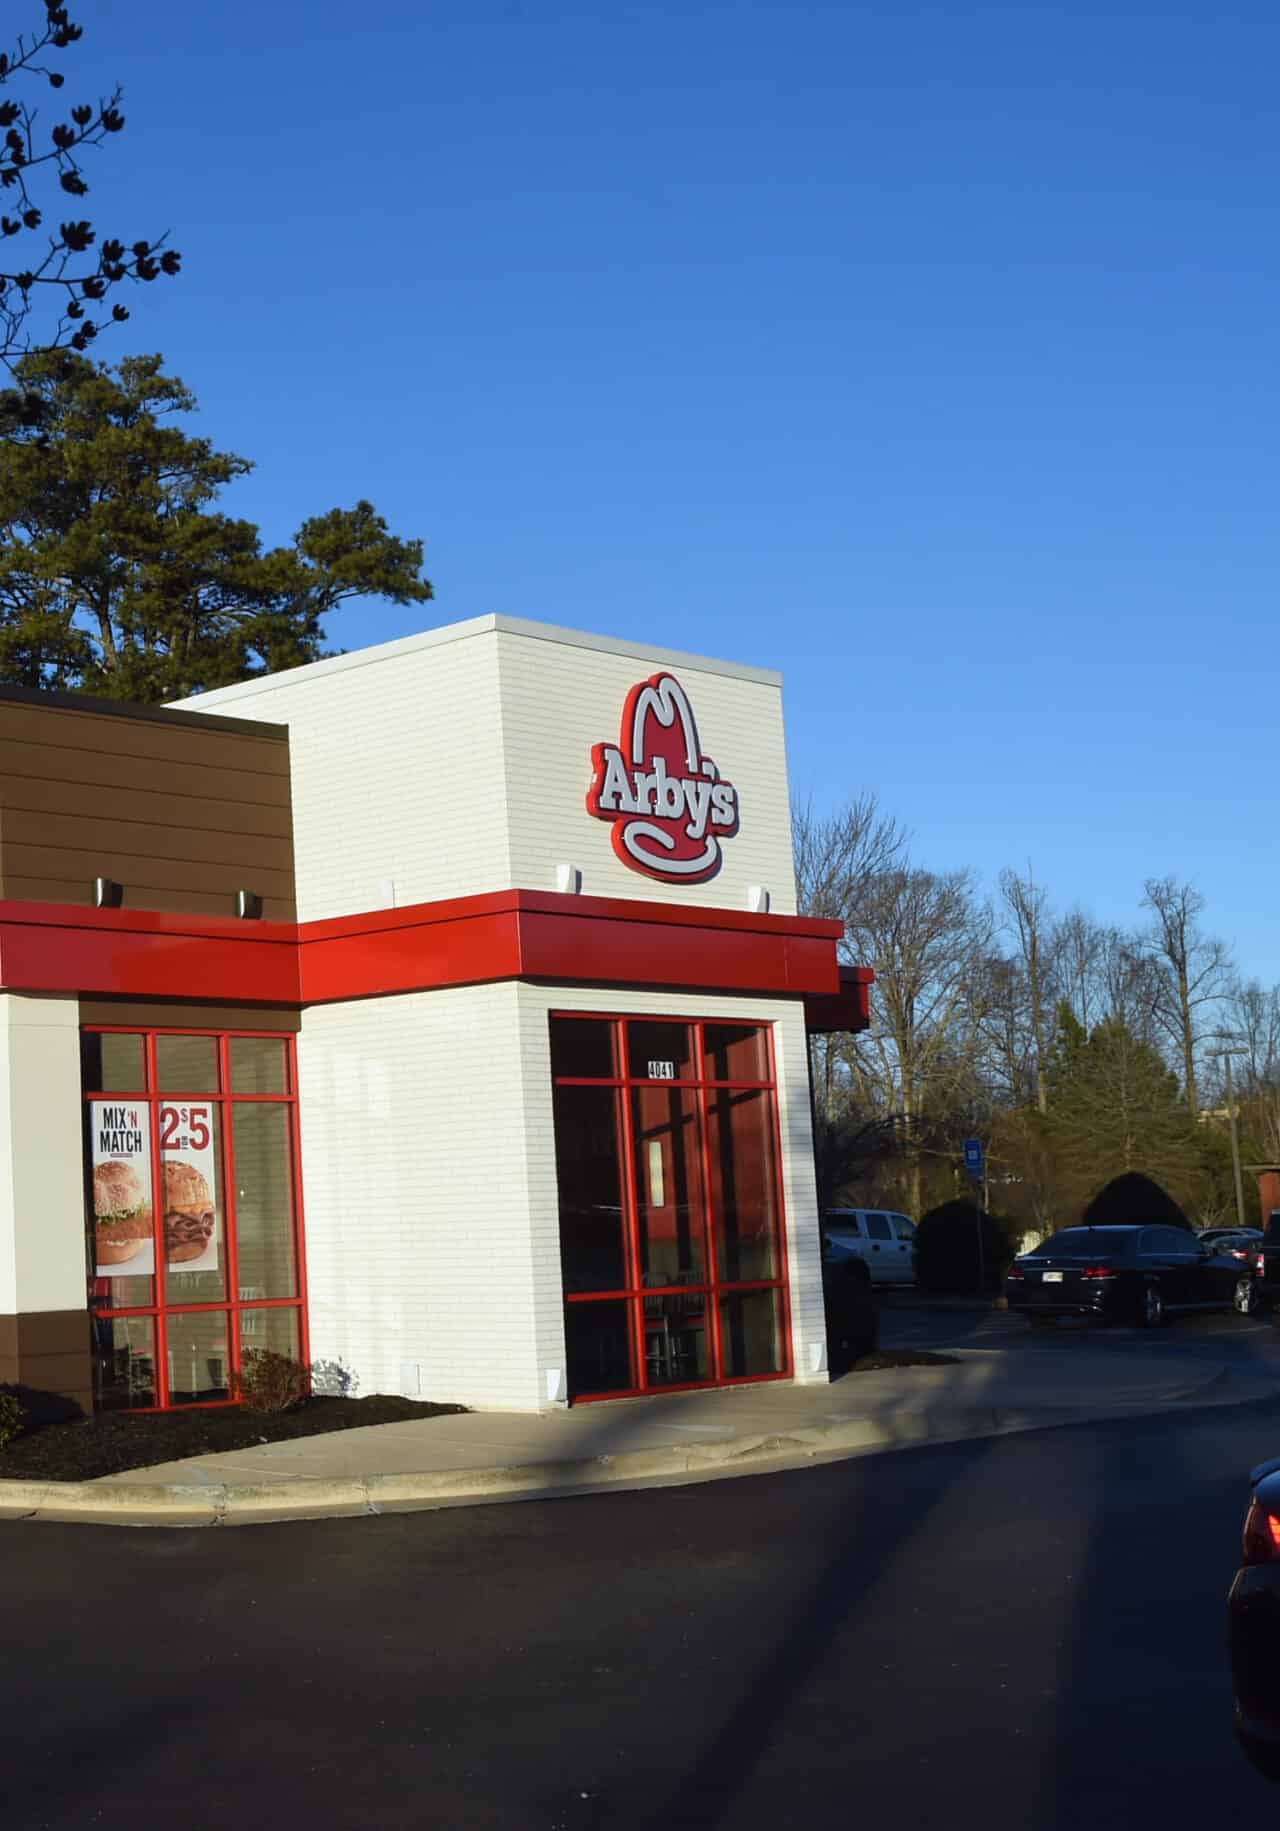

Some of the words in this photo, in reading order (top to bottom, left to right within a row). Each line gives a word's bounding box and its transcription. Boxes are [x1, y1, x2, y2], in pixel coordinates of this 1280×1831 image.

[599, 748, 736, 839] Arby's
[649, 1062, 673, 1078] 4041
[103, 1107, 127, 1129] MIX
[100, 1130, 142, 1153] MATCH
